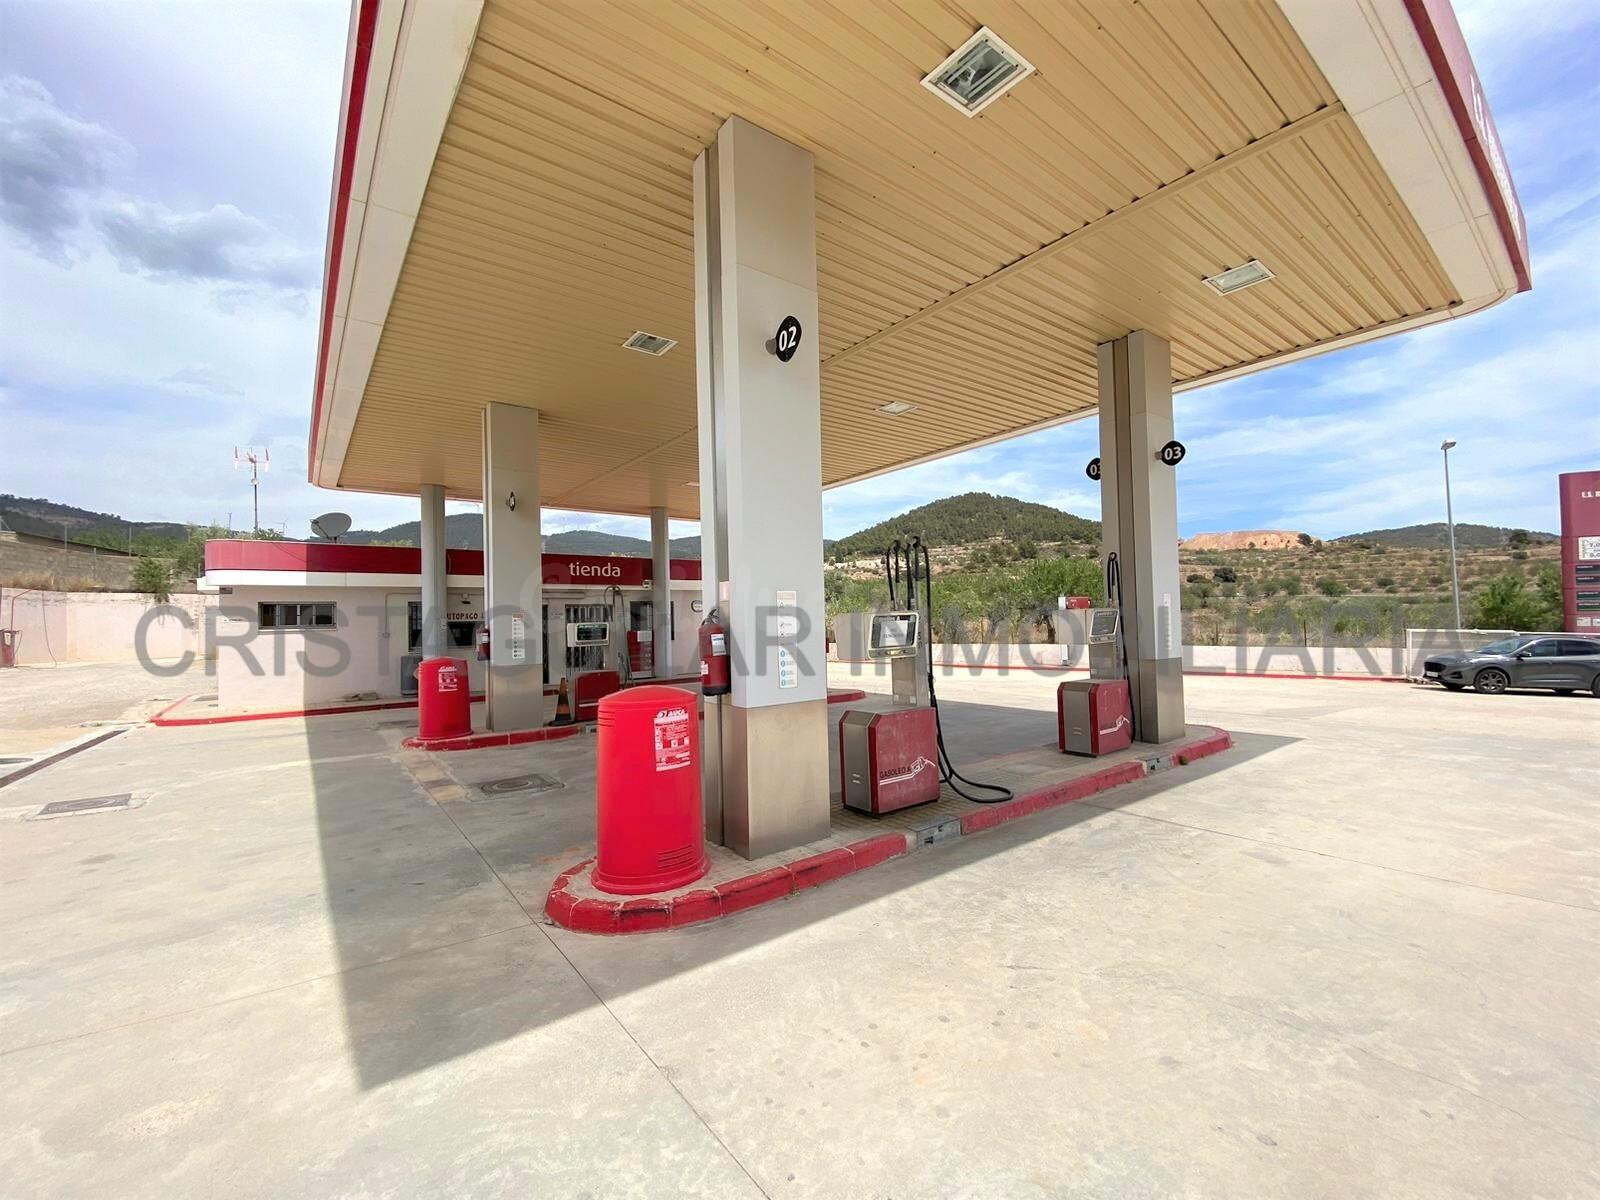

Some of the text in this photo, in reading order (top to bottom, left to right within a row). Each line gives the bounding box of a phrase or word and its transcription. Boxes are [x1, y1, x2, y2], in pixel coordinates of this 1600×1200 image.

[779, 325, 797, 352] 02
[1164, 446, 1182, 460] 03
[569, 562, 621, 577] tienda
[446, 612, 479, 621] UTOPAGO
